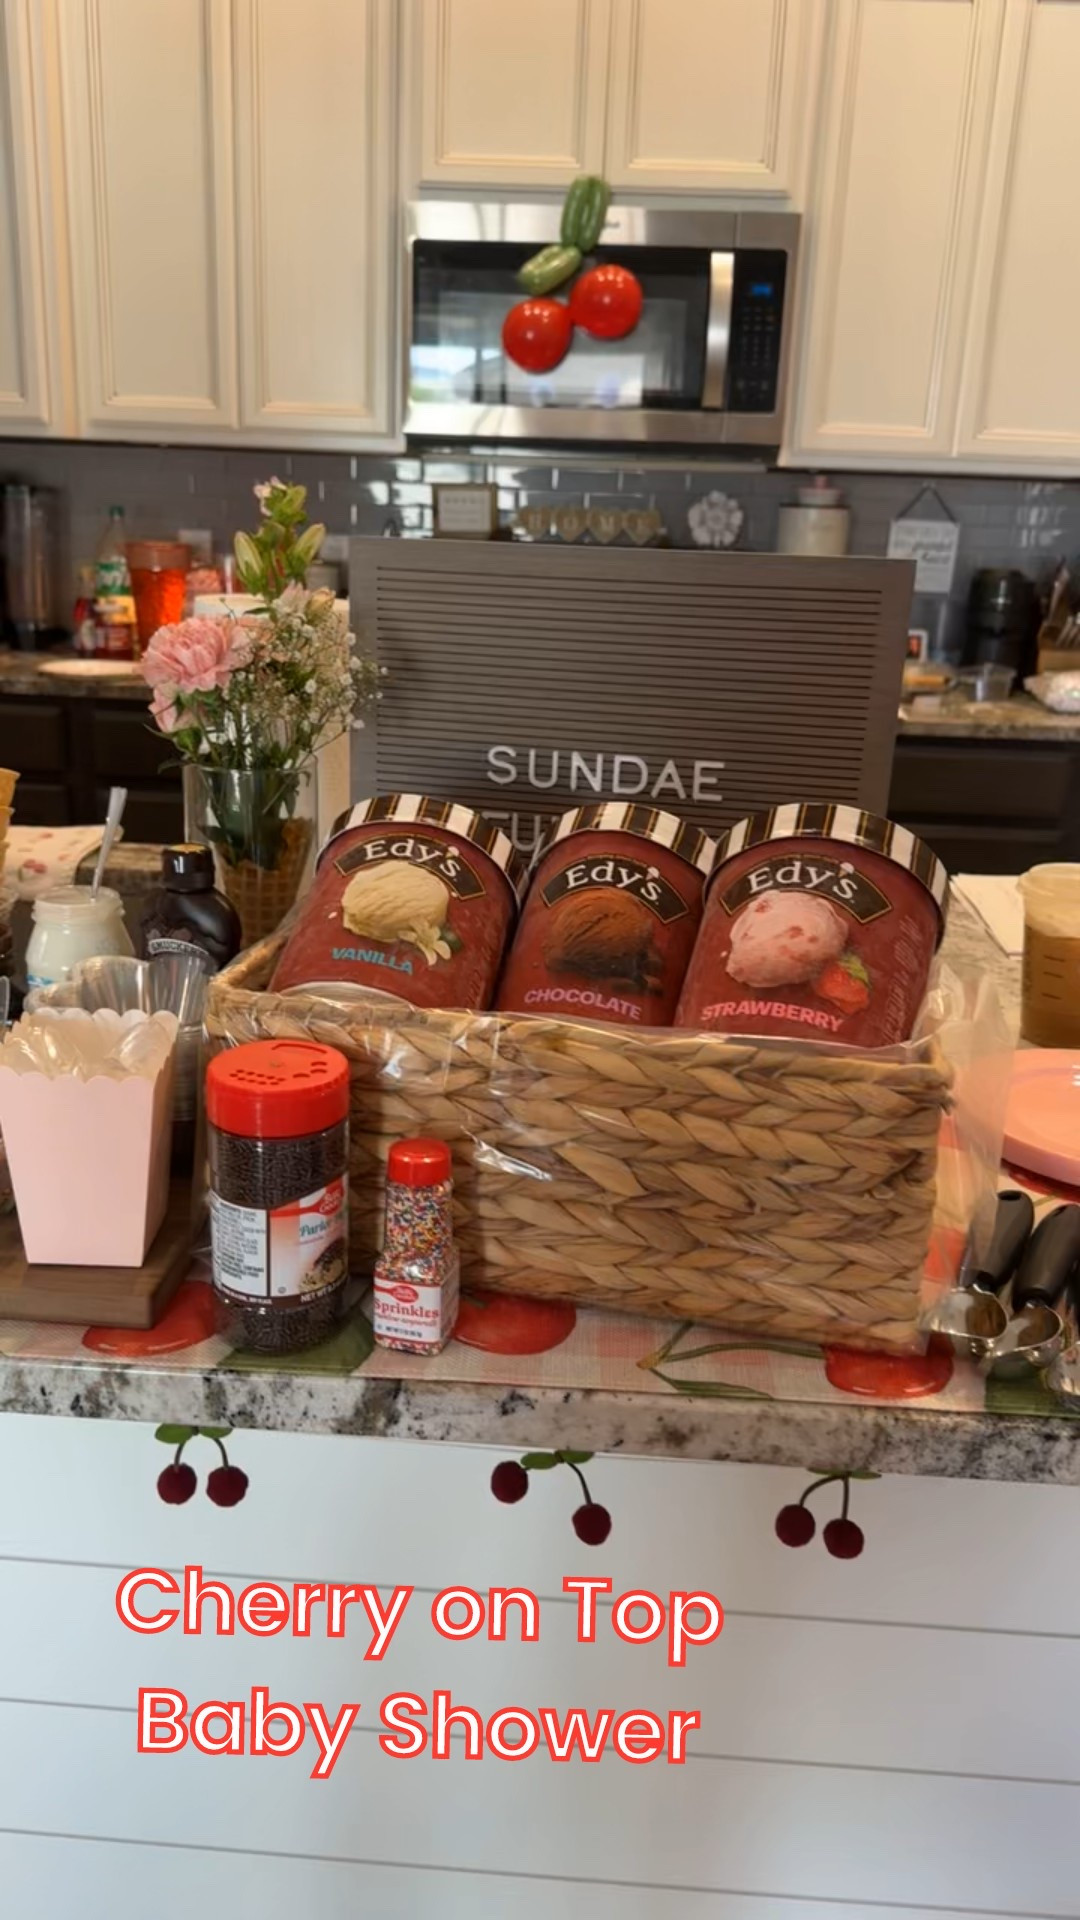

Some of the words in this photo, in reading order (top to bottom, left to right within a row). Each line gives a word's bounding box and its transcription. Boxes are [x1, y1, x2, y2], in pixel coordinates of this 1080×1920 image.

[486, 745, 725, 801] SUNDAE
[363, 838, 461, 878] Edy's
[565, 861, 662, 901] Edy's
[747, 861, 858, 899] Edy's
[332, 948, 413, 975] VANILLA
[524, 988, 642, 1020] CHOCOLATE
[701, 1001, 843, 1032] STRAWBERRY
[374, 1300, 440, 1318] Sprinkles
